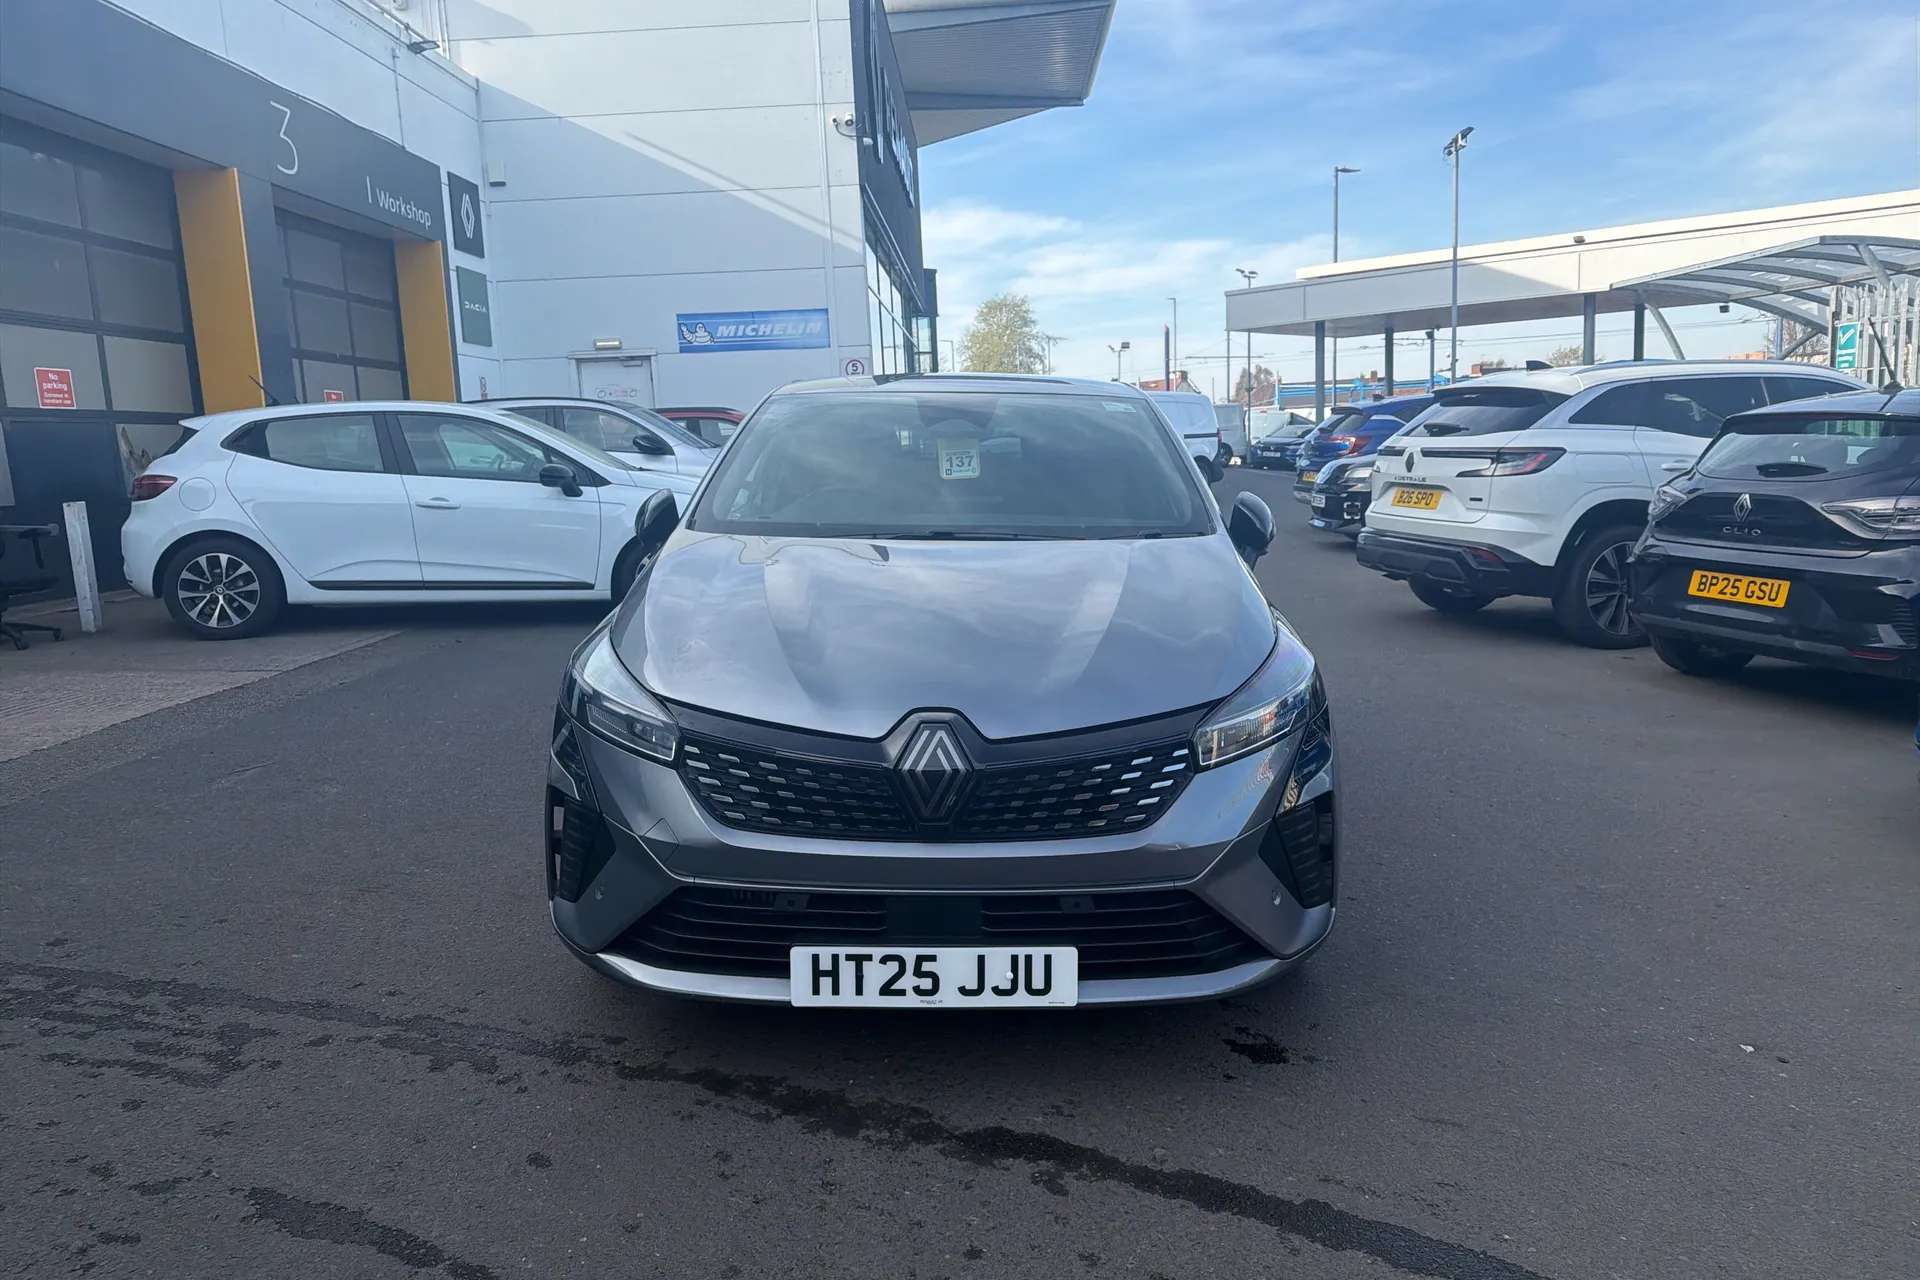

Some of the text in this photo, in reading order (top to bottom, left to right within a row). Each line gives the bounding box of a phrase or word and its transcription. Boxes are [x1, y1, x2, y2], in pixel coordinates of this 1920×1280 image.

[270, 100, 299, 175] 3
[376, 188, 432, 230] Workshop
[716, 320, 822, 338] MICHELIN
[851, 361, 859, 372] 5
[48, 372, 59, 381] No
[42, 381, 68, 392] parking
[945, 455, 975, 468] 137
[1722, 526, 1761, 536] CLIO
[1697, 574, 1782, 602] BP25 GSU
[811, 953, 1053, 997] HT25 JJU
